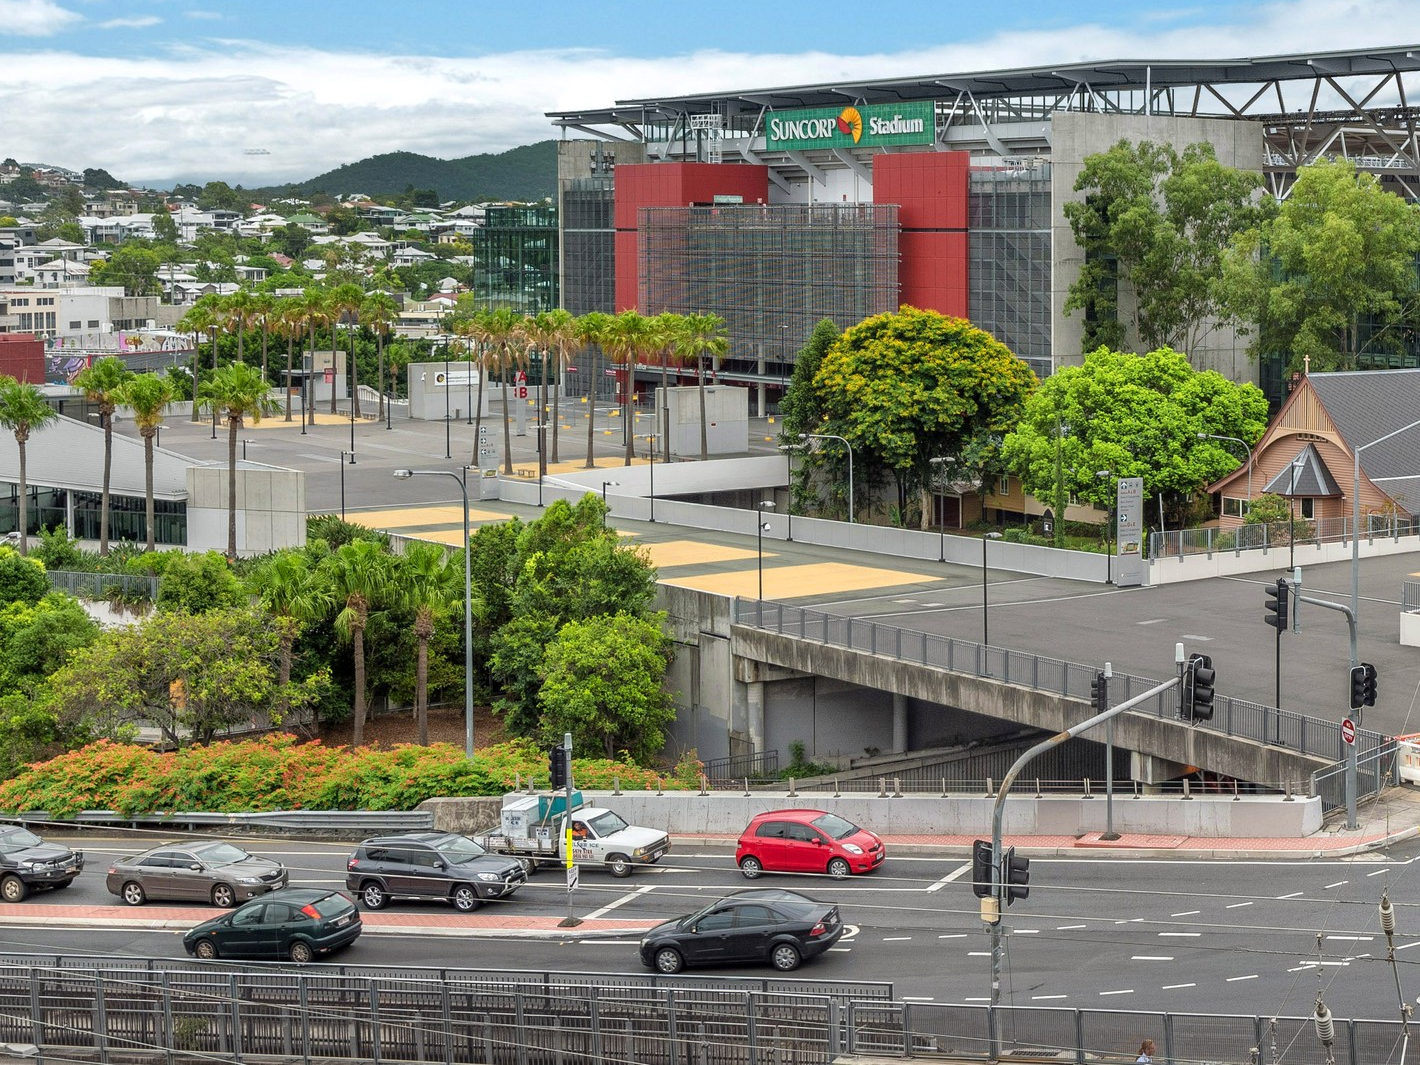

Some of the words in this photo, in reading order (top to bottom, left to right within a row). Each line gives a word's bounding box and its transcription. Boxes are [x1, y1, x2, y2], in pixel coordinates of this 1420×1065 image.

[770, 118, 836, 141] SUNCORP
[869, 114, 924, 135] Stadium
[518, 370, 527, 382] A
[519, 387, 528, 398] B
